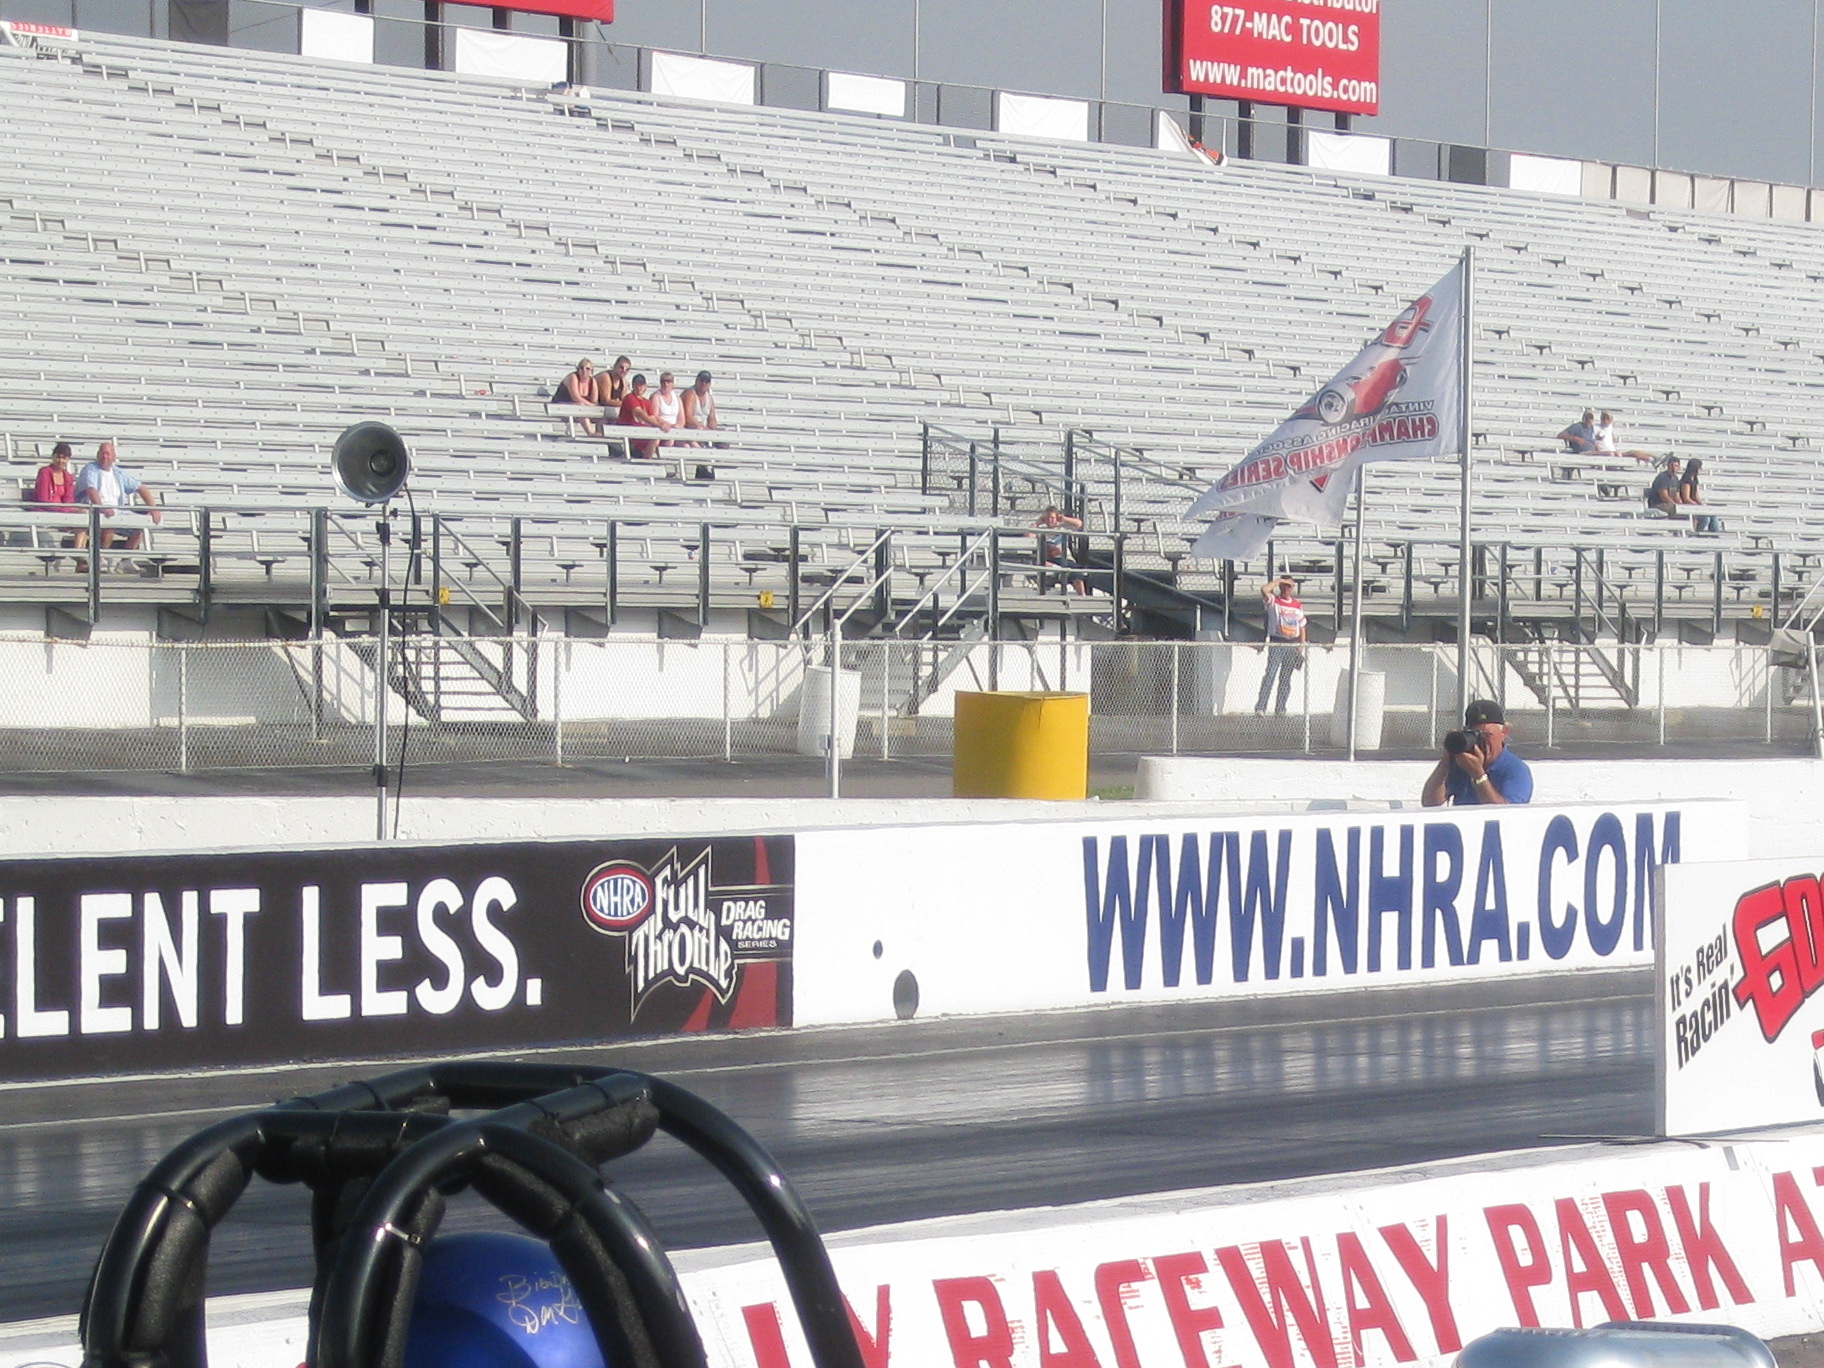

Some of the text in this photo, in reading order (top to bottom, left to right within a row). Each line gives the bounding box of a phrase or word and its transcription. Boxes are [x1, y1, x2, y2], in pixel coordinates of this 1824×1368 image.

[1210, 4, 1359, 51] 877-MAC TOOLS
[1189, 59, 1377, 103] www.mactools.com
[597, 878, 643, 917] NHRA
[721, 899, 766, 926] DRAG
[1083, 811, 1681, 992] WWW.NHRA.COM
[732, 918, 791, 940] RACING
[737, 941, 777, 949] SERIES
[0, 876, 542, 1038] LENT LESS.
[1670, 921, 1728, 1013] It's Real
[1675, 961, 1735, 1072] Racin'
[1482, 1181, 1757, 1330] PARK
